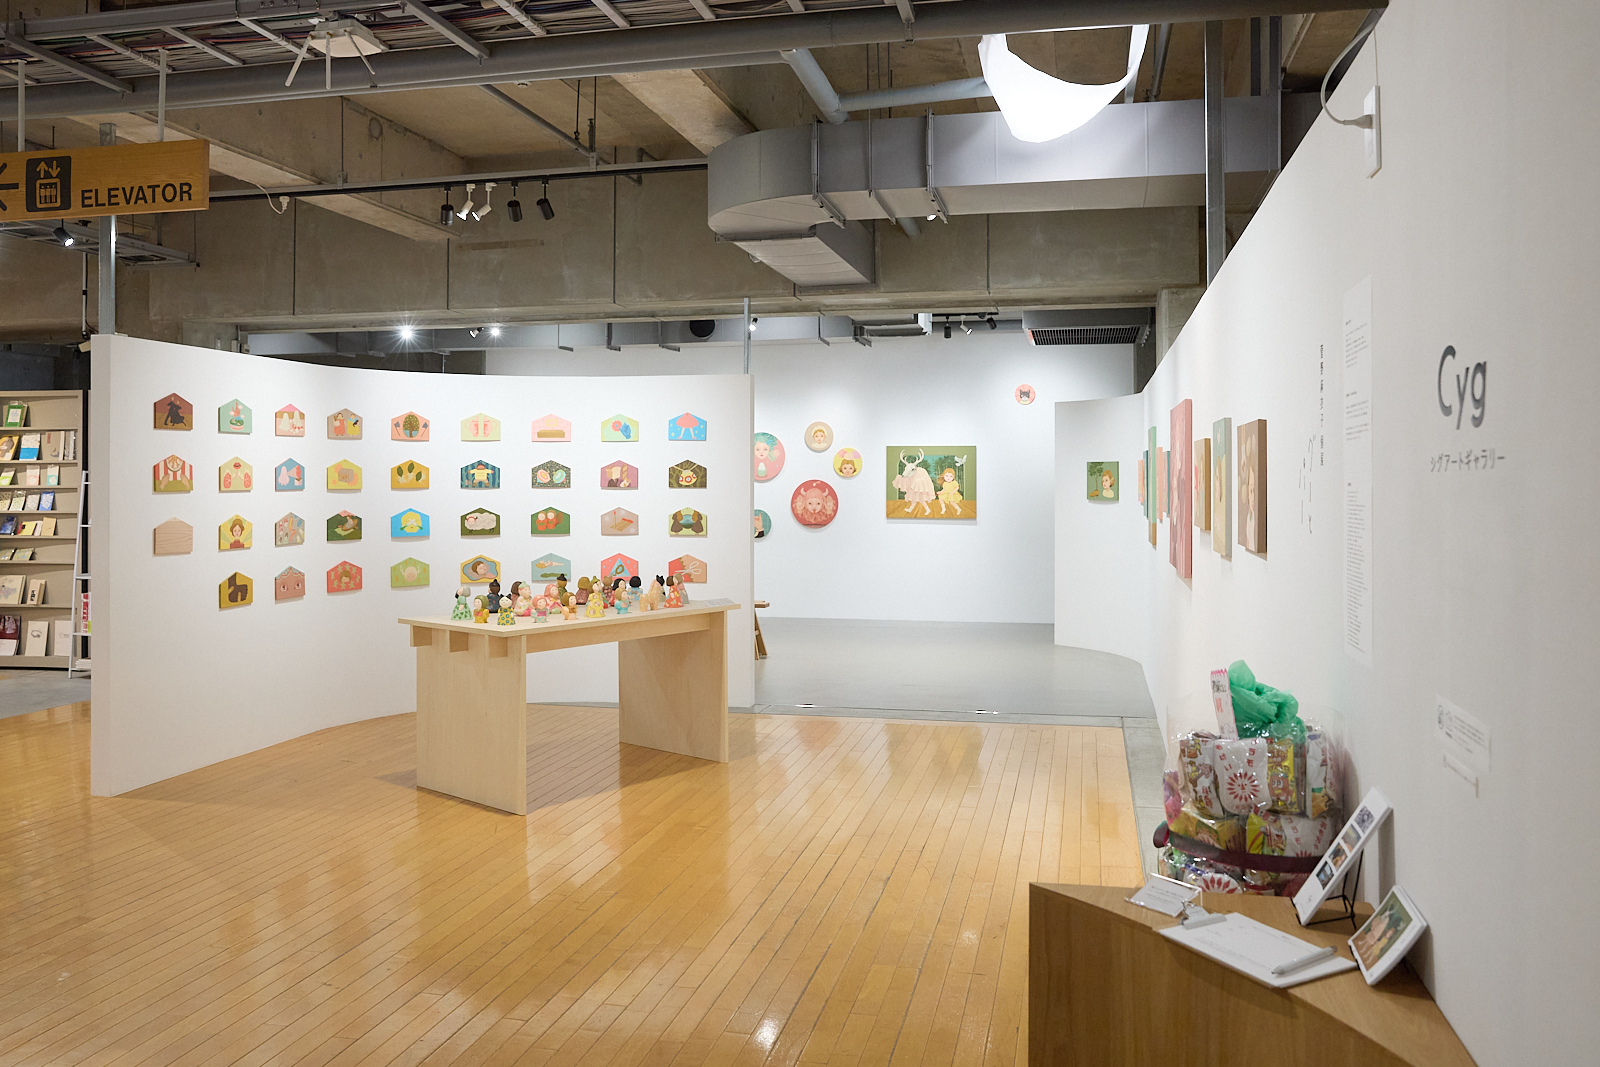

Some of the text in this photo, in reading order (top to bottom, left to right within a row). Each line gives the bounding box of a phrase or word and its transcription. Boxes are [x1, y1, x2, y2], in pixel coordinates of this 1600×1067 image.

[81, 182, 193, 208] ELEVATOR
[1437, 344, 1487, 430] Cyg
[1430, 448, 1506, 473] シグアートギャラリー
